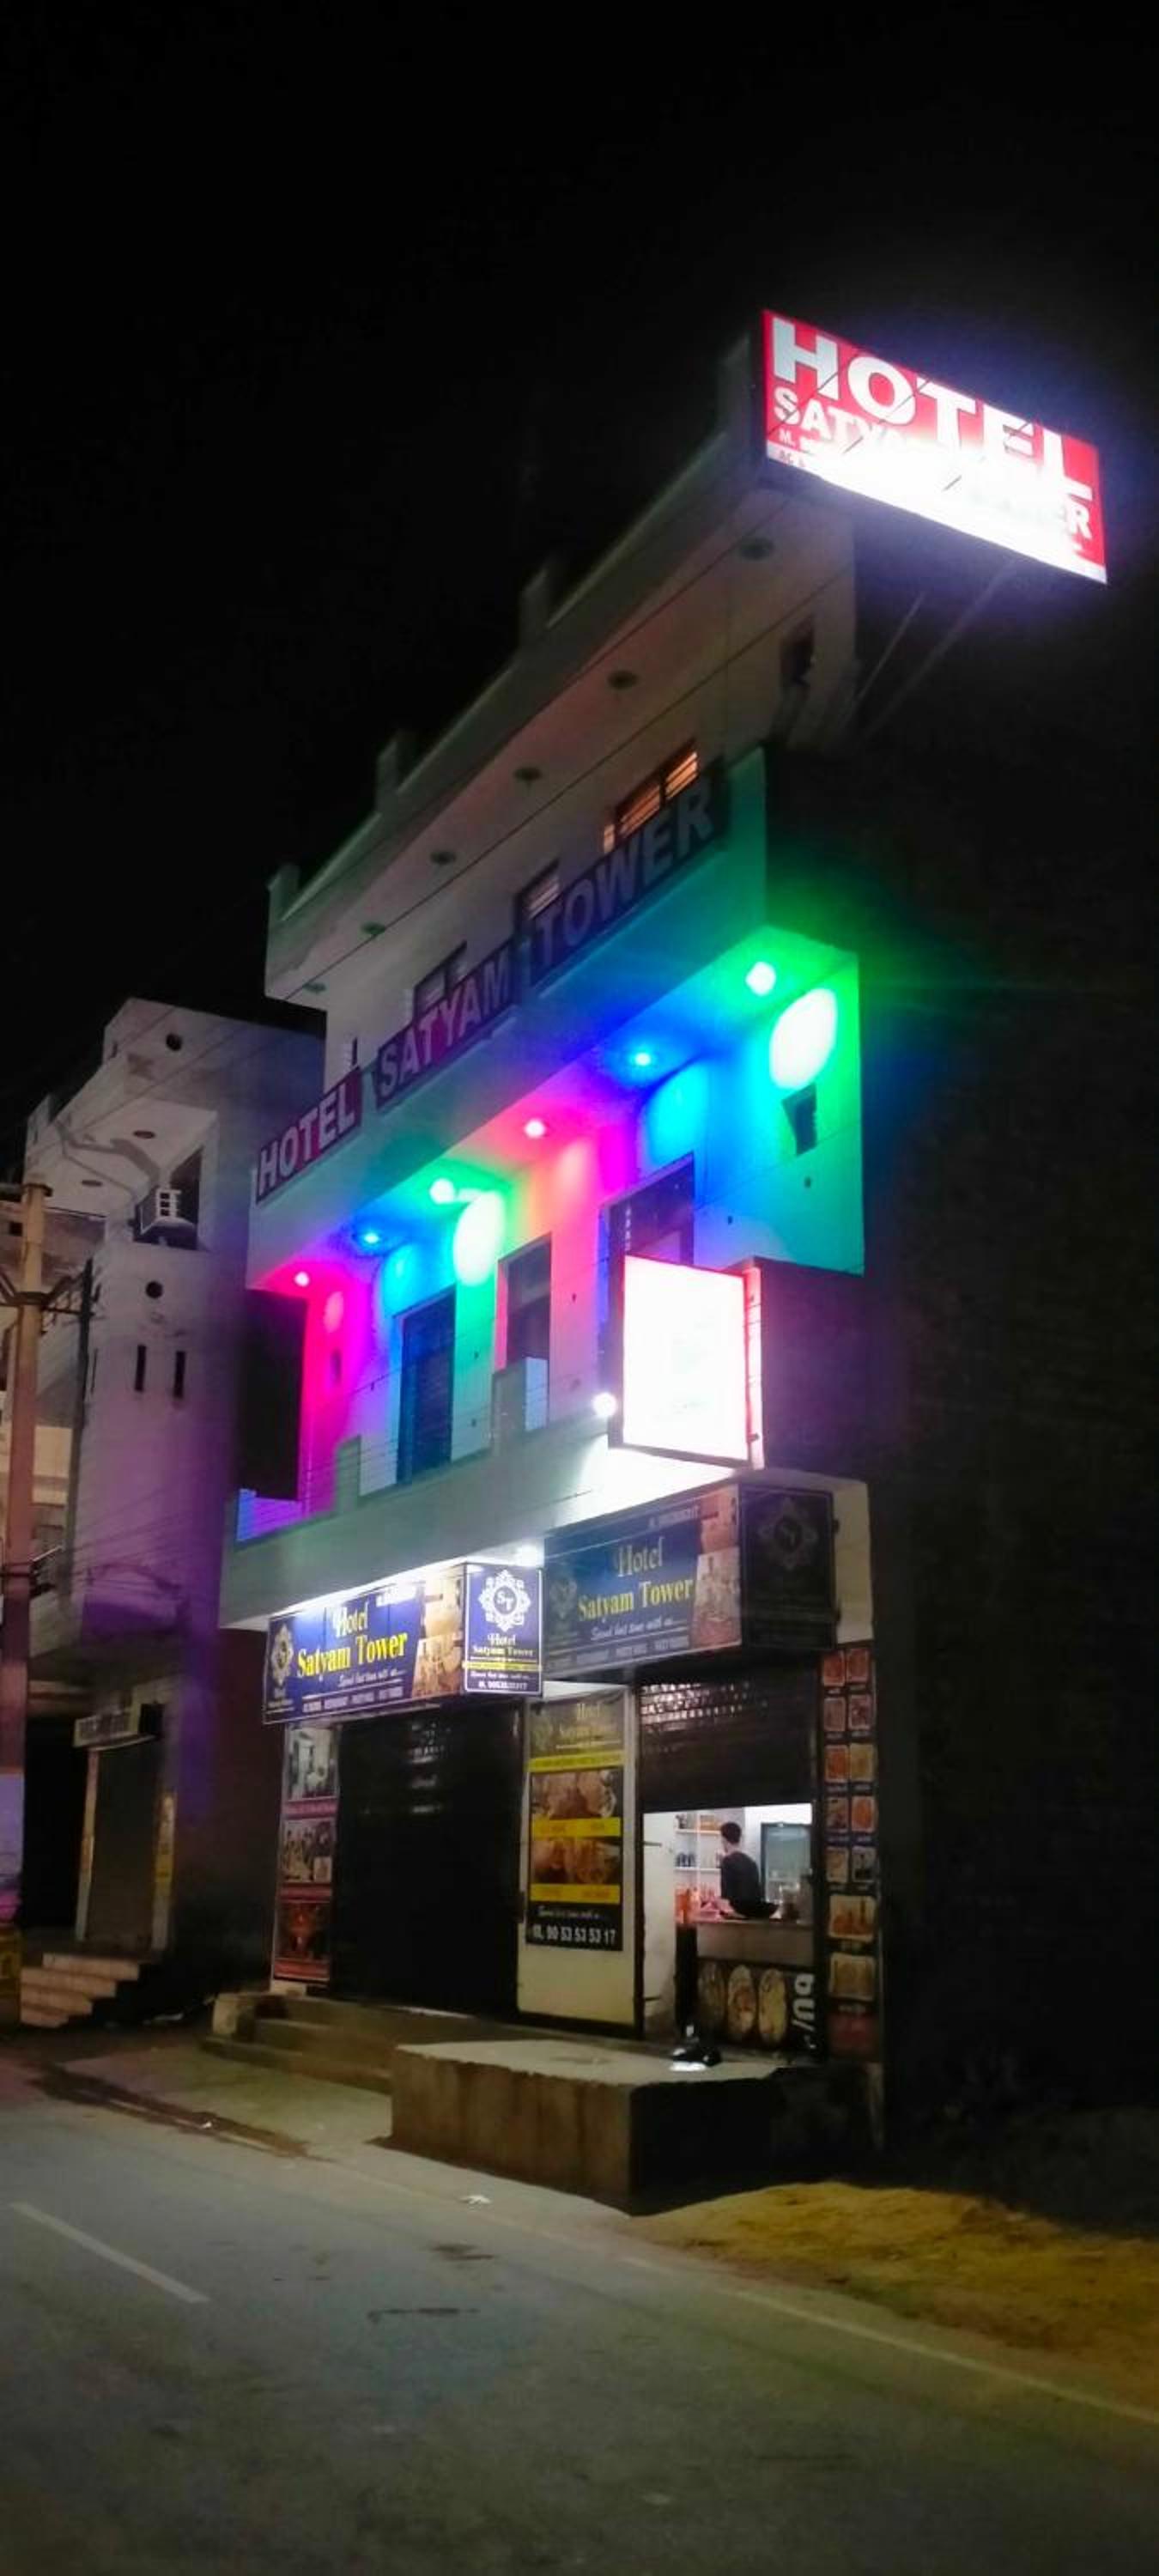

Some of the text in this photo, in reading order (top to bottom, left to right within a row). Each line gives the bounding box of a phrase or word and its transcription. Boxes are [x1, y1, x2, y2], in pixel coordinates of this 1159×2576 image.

[774, 317, 1093, 501] HOTEL
[258, 769, 715, 1195] HOTEL SATYAM TOWER
[616, 1536, 665, 1577] Hotel
[332, 1601, 368, 1637] Hotel
[578, 1577, 694, 1623] Satyam Tower
[296, 1631, 408, 1682] Satyam Tower
[604, 1929, 617, 1946] 17
